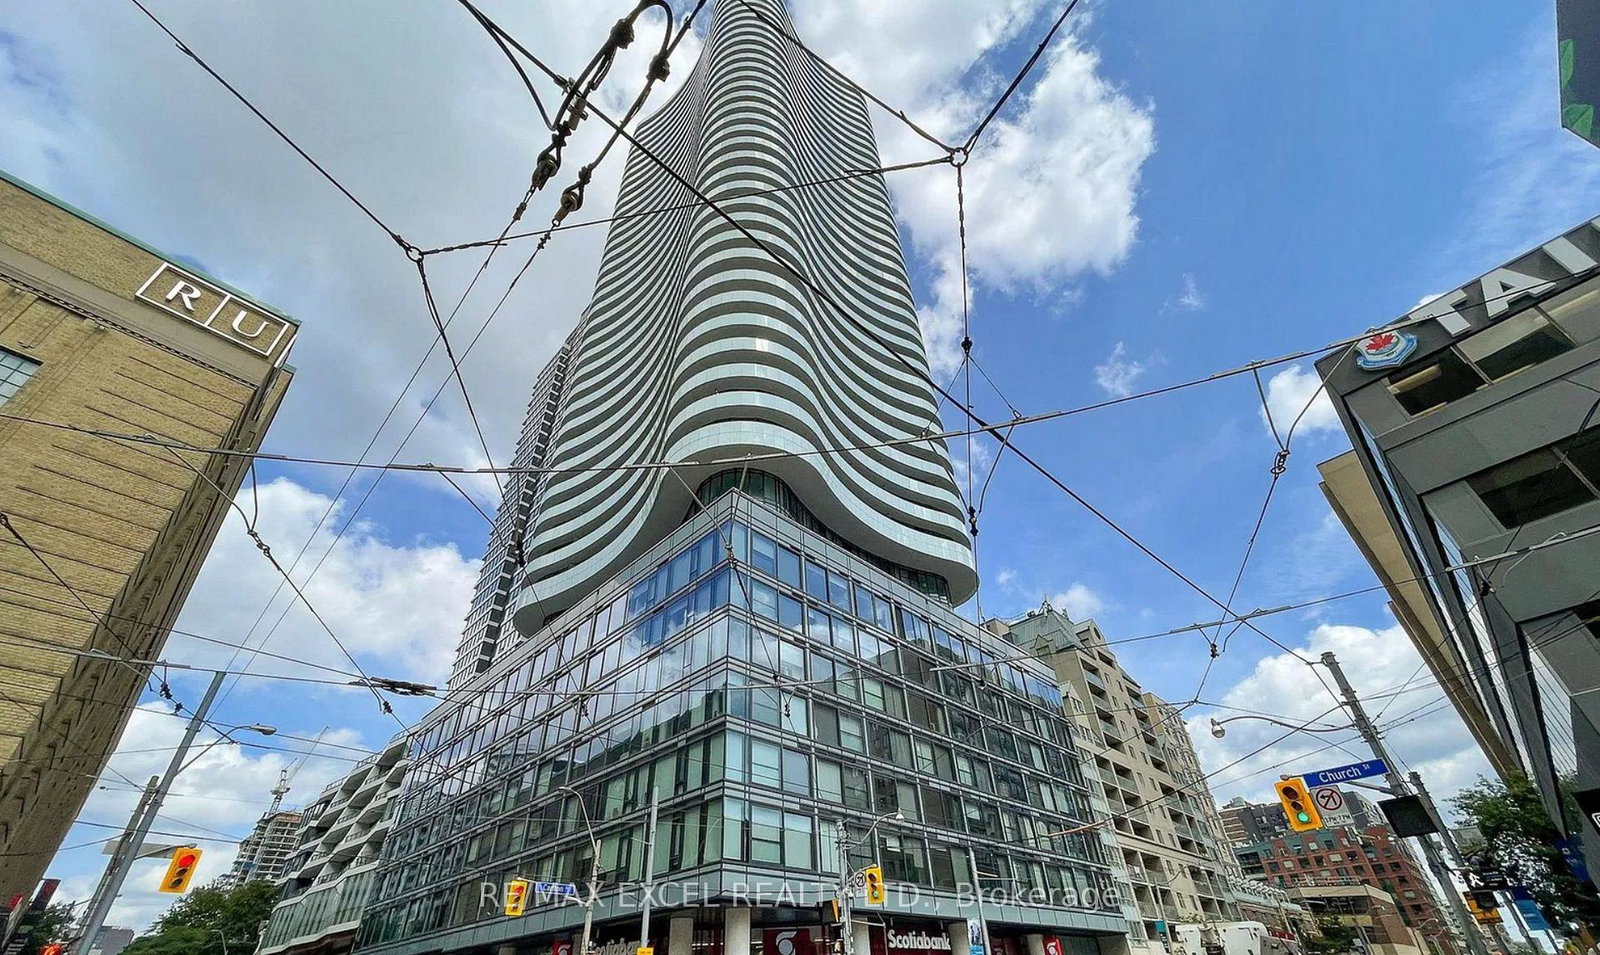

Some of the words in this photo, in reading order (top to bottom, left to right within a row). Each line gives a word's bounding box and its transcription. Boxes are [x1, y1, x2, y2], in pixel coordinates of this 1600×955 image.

[1407, 214, 1600, 339] TAI
[1318, 767, 1362, 783] Church
[587, 937, 641, 955] otiaba
[887, 929, 951, 950] Scotiabank
